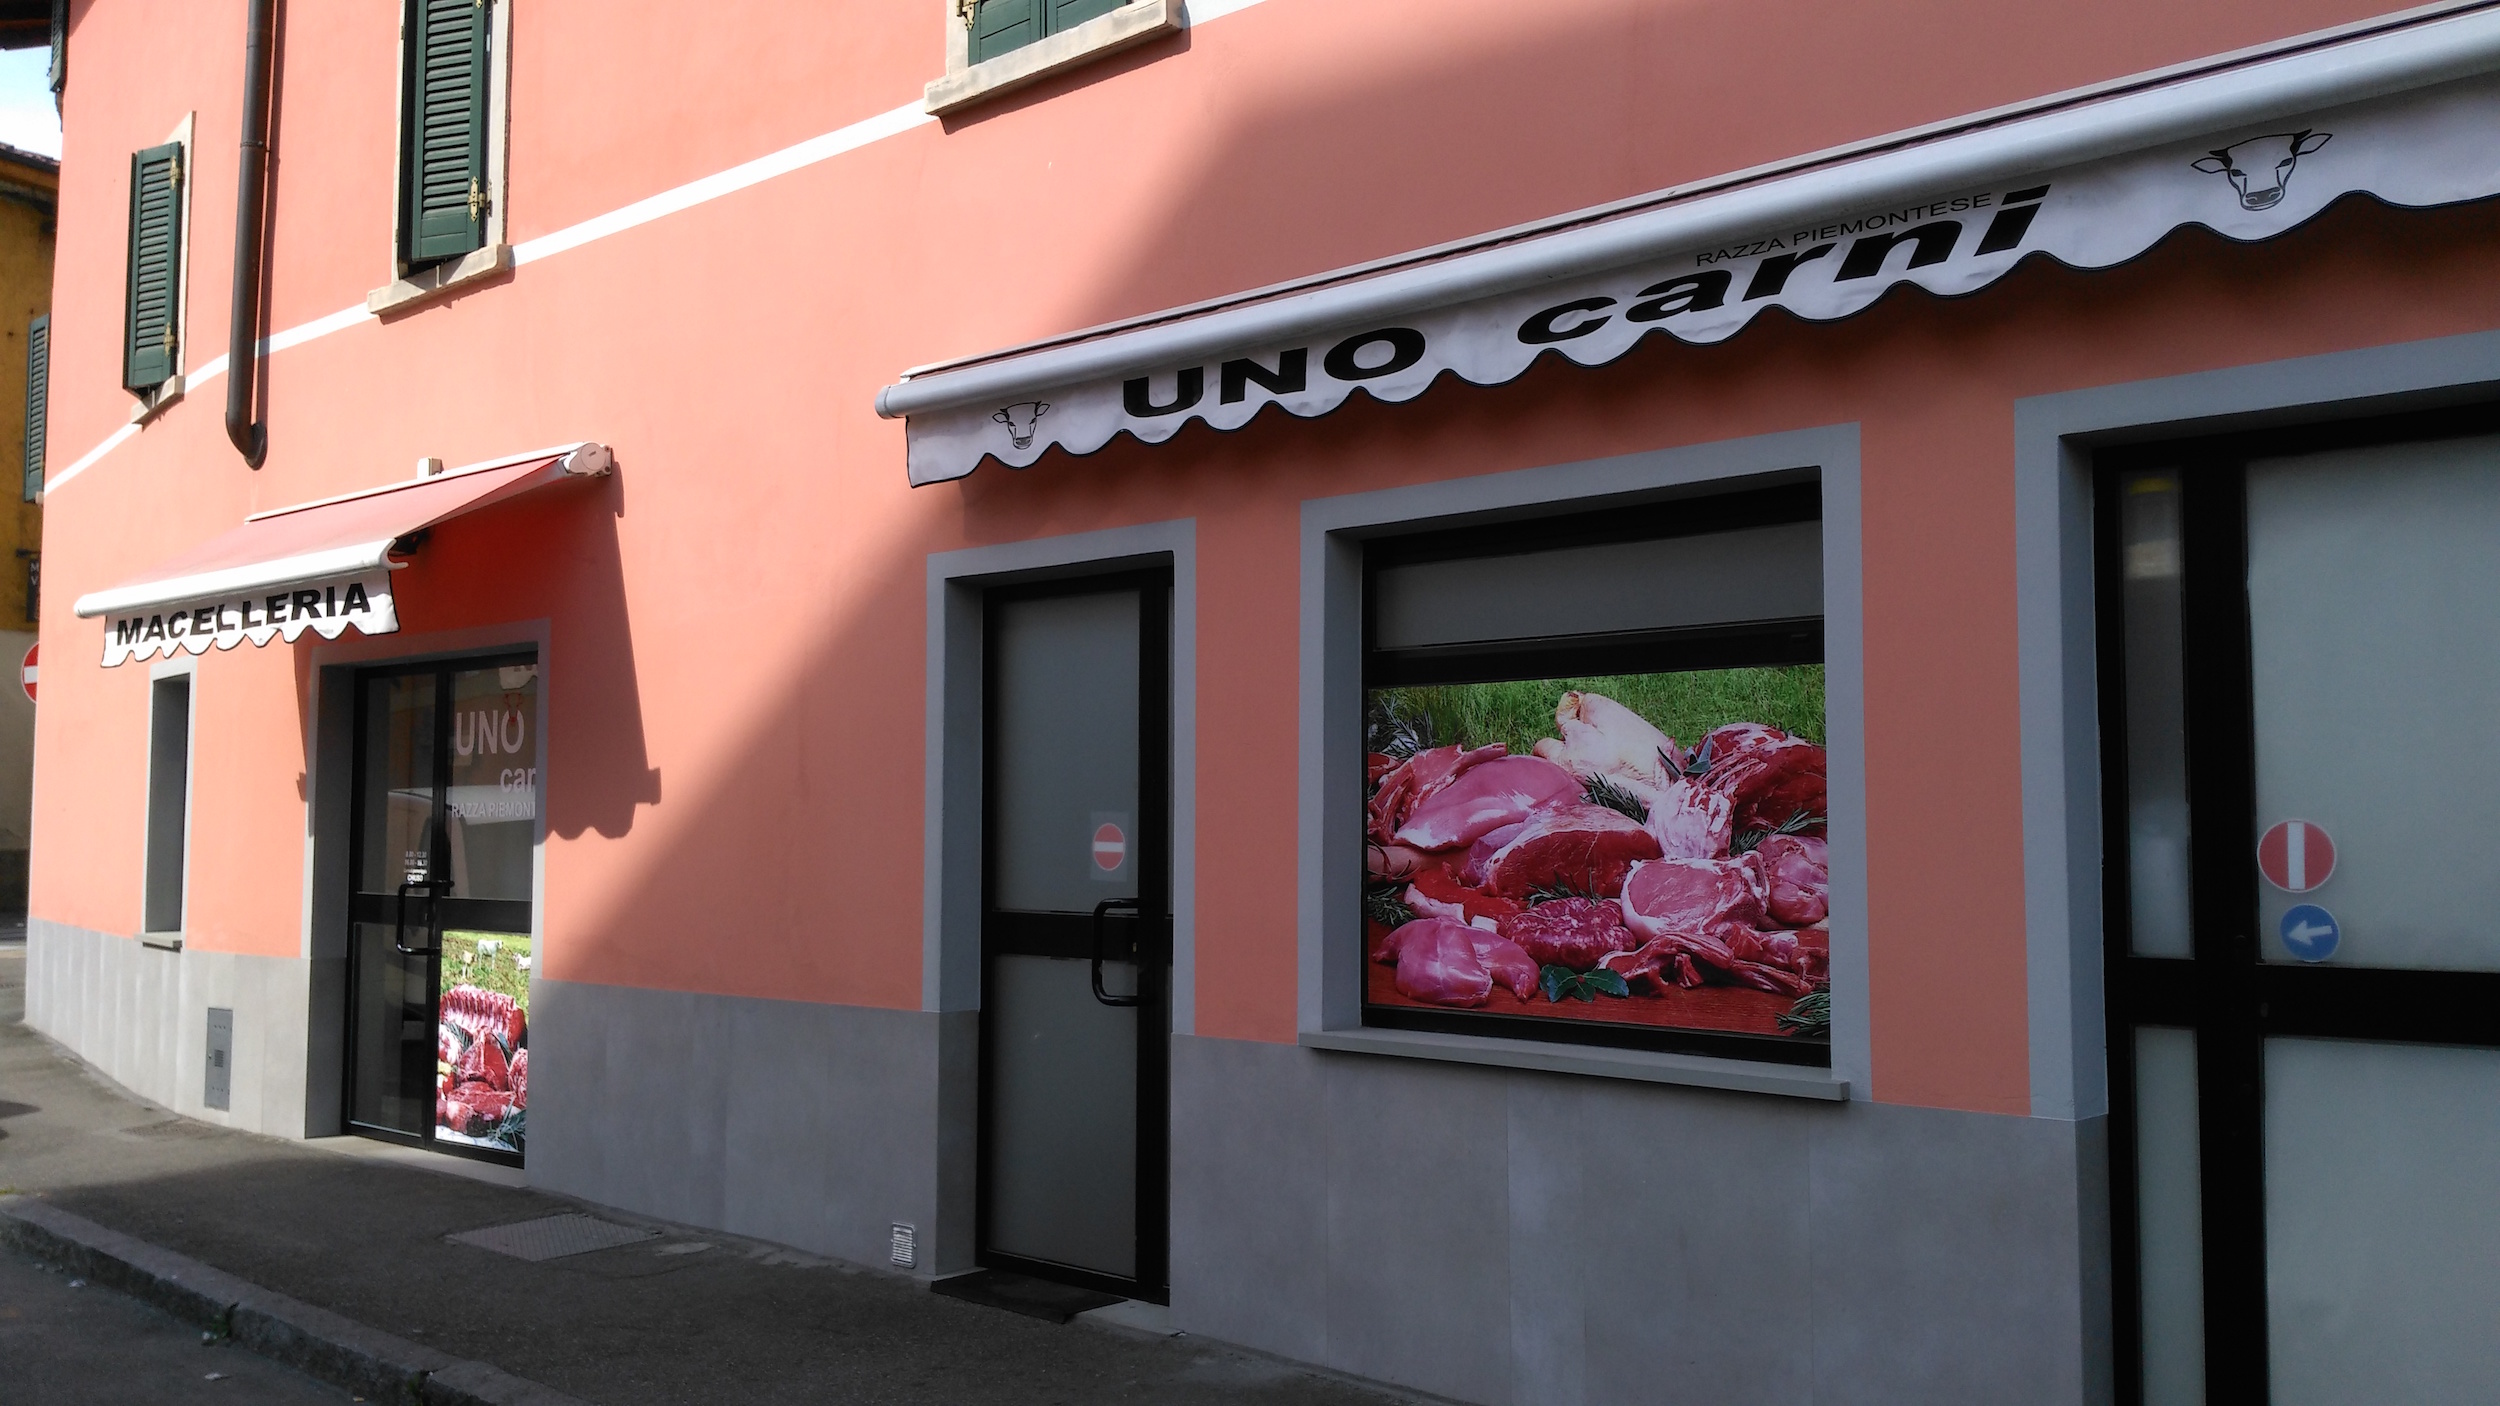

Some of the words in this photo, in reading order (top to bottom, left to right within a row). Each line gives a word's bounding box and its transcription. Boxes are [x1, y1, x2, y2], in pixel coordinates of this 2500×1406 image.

[1696, 237, 1785, 267] RAZZA
[1793, 192, 1991, 244] PIEMONTESE
[1123, 327, 1426, 418] UNO
[1517, 184, 2051, 344] carni
[116, 583, 371, 646] MACELLERIA
[455, 709, 524, 756] UNO
[451, 802, 486, 818] RAZZA
